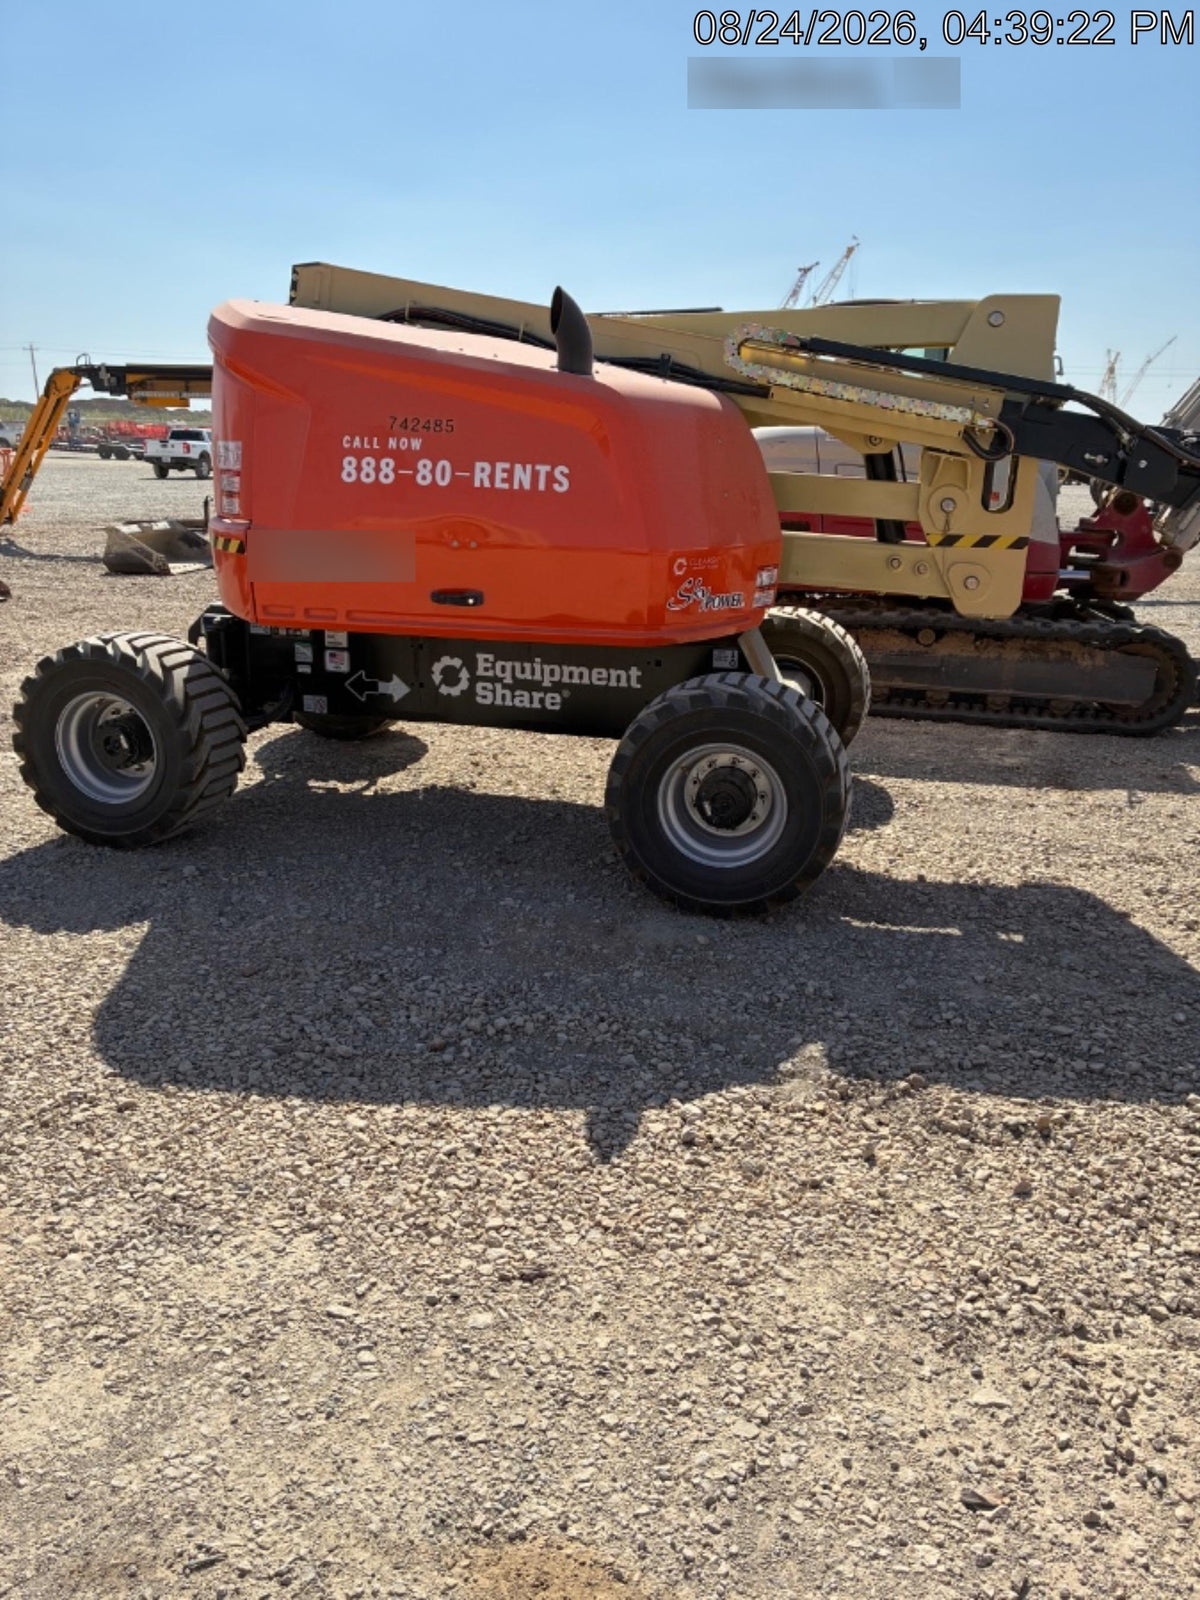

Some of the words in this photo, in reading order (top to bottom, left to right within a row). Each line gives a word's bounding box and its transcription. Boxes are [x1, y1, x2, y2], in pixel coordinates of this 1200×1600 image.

[389, 416, 455, 434] 742485
[342, 435, 380, 449] CALL
[388, 437, 423, 451] NOW
[341, 456, 571, 493] 888-80-RENTS
[475, 652, 643, 689] Equipment
[475, 682, 562, 711] Share
